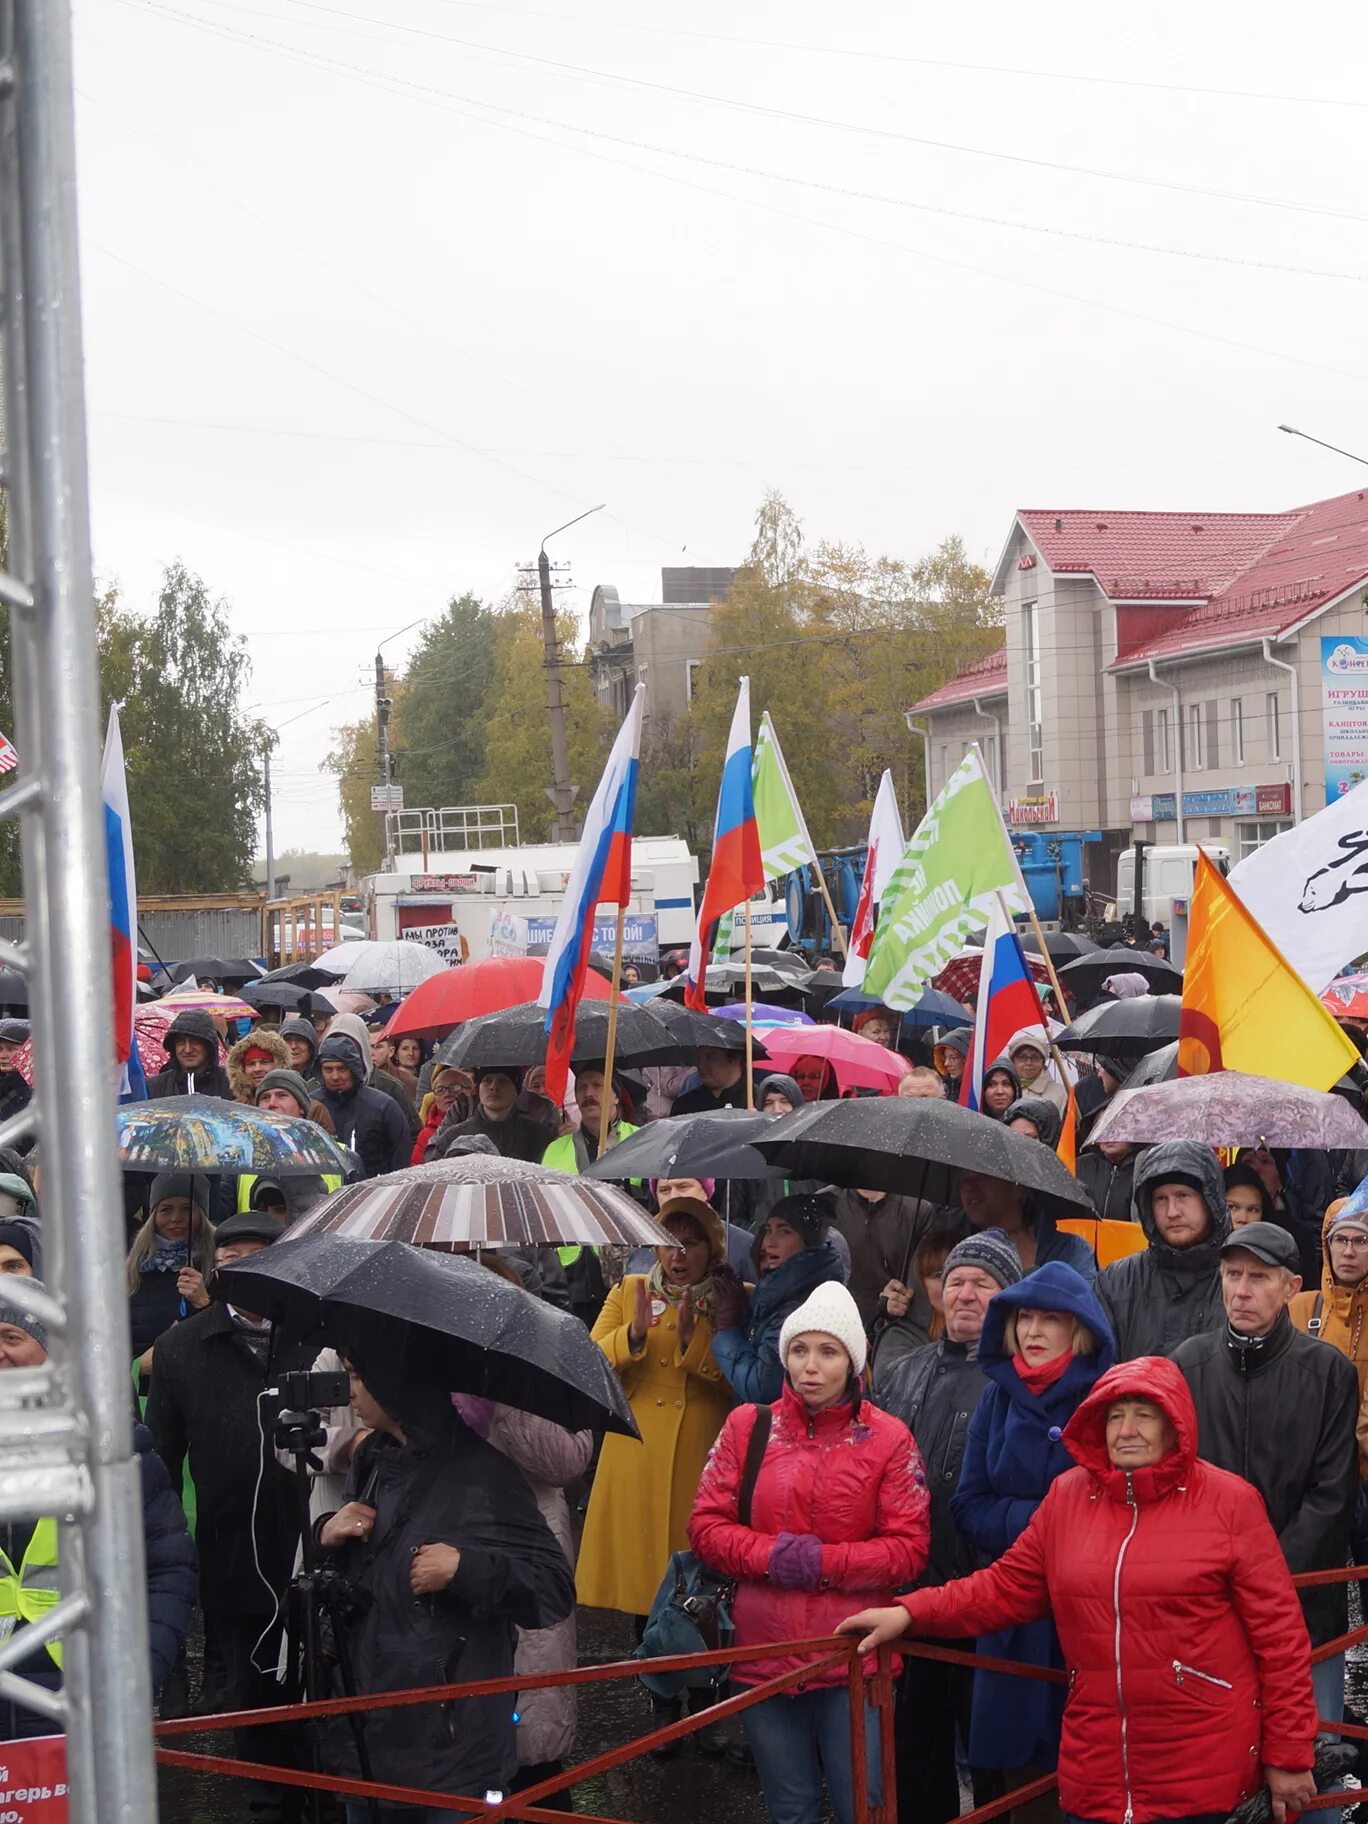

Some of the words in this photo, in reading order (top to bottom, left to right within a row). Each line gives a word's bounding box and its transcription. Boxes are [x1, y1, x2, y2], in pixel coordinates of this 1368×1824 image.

[735, 915, 772, 926] ПОИЦИЯ
[405, 931, 422, 940] МЫ
[426, 927, 459, 938] ПРОТИВ
[601, 924, 643, 941] ТООЙ!
